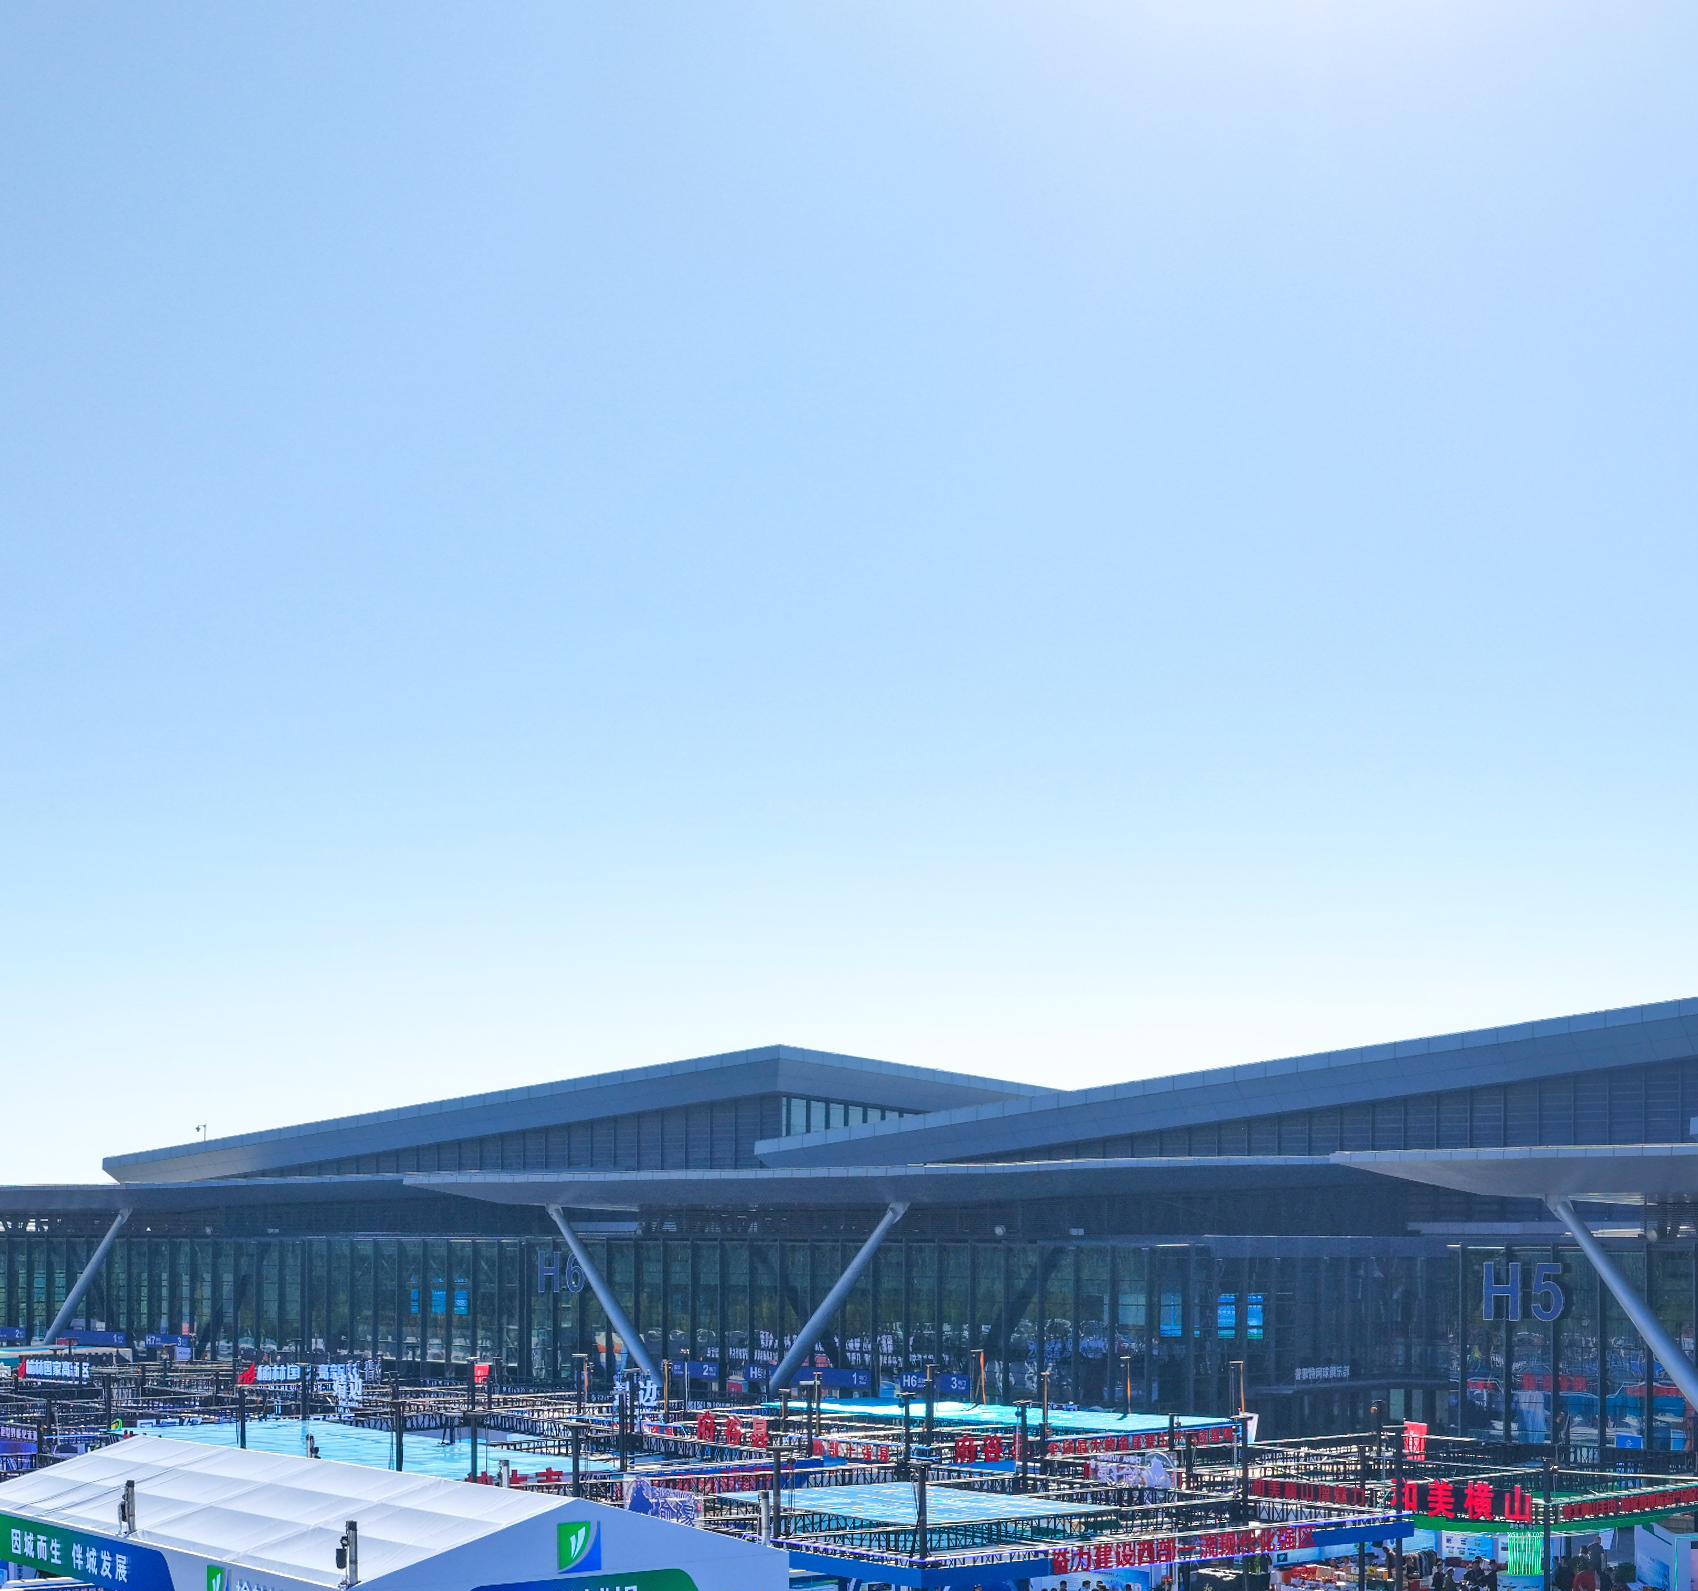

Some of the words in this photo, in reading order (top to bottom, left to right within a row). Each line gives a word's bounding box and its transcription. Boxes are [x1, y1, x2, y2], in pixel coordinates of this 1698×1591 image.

[1482, 1260, 1567, 1322] H5
[26, 1357, 90, 1385] 榆林国家高新区
[1390, 1478, 1532, 1523] 和美横山
[11, 1528, 62, 1566] 因城而生
[71, 1543, 129, 1584] 伴城发展
[1051, 1525, 1317, 1575] 奋力建设西部一流现代化强区
